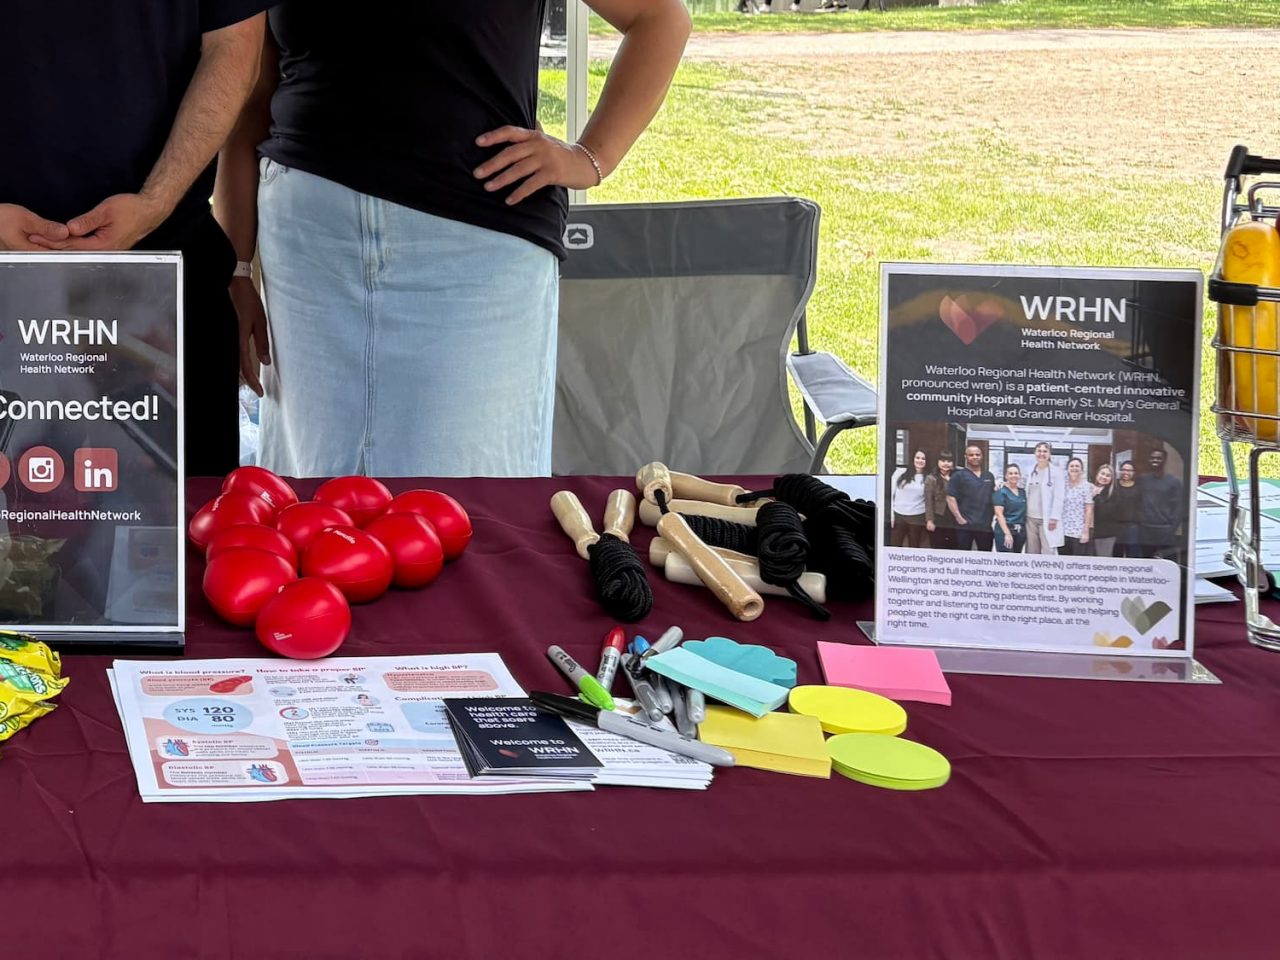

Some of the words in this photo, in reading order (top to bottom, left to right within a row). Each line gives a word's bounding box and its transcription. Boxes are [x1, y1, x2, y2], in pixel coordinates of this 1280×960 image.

[1020, 295, 1126, 323] WRHN
[17, 319, 118, 345] WRHN
[1021, 327, 1068, 338] Waterloo
[1069, 329, 1115, 341] Regional
[1021, 339, 1055, 349] Health
[1057, 341, 1101, 351] Network
[20, 352, 64, 362] Waterloo
[65, 352, 108, 364] Regional
[20, 364, 52, 374] Health
[54, 364, 95, 374] Network
[925, 365, 976, 376] Waterloo
[978, 366, 1026, 379] Regional
[1028, 368, 1066, 379] Health
[1068, 370, 1116, 381] Network
[1118, 371, 1161, 383] (WRHN,
[902, 379, 969, 389] pronounced
[971, 381, 1003, 392] wren)
[1005, 381, 1015, 390] is
[1017, 383, 1024, 391] a
[1026, 382, 1121, 394] patient-centred
[1123, 386, 1186, 397] innovative
[906, 392, 972, 404] community
[974, 394, 1026, 406] Hospital.
[1028, 395, 1078, 409] Formerly
[1080, 397, 1095, 408] St.
[1097, 398, 1134, 410] Mary's
[1136, 399, 1181, 410] General
[947, 406, 993, 418] Hospital
[995, 408, 1016, 418] and
[1018, 409, 1053, 419] Grand
[1054, 410, 1082, 420] River
[1084, 411, 1135, 423] Hospital.
[888, 553, 926, 562] Waterloo
[927, 555, 964, 565] Regional
[965, 557, 993, 566] Health
[994, 558, 1029, 567] Network
[1031, 559, 1065, 570] (WRHN)
[1066, 562, 1091, 570] offers
[1119, 565, 1153, 574] regional
[888, 565, 927, 574] programs
[929, 566, 945, 574] and
[946, 567, 959, 575] full
[960, 568, 1005, 577] healthcare
[1007, 571, 1042, 579] services
[1054, 573, 1087, 582] support
[1088, 574, 1118, 583] people
[1128, 576, 1171, 585] Waterloo-
[888, 575, 931, 585] Wellington
[933, 577, 949, 585] and
[950, 579, 984, 587] beyond.
[985, 580, 1009, 588] We're
[1010, 581, 1045, 590] focused
[1059, 584, 1095, 594] breaking
[1096, 585, 1120, 593] down
[1121, 587, 1156, 596] barriers,
[888, 586, 928, 597] improving
[952, 589, 968, 597] and
[969, 591, 1000, 600] putting
[1001, 592, 1037, 601] patients
[1038, 594, 1057, 602] first.
[1070, 596, 1104, 605] working
[887, 609, 917, 617] people
[917, 610, 932, 618] get
[933, 610, 948, 618] the
[949, 611, 969, 620] right
[970, 613, 991, 621] care,
[1002, 614, 1016, 622] the
[1017, 615, 1038, 624] right
[1039, 616, 1064, 624] place,
[888, 598, 924, 607] together
[925, 599, 942, 607] and
[943, 600, 978, 610] listening
[1006, 603, 1062, 613] communities,
[1063, 606, 1087, 614] we're
[1087, 608, 1120, 617] helping
[887, 620, 907, 628] right
[908, 620, 929, 628] time.
[202, 706, 234, 714] 120
[528, 746, 580, 754] WRHN
